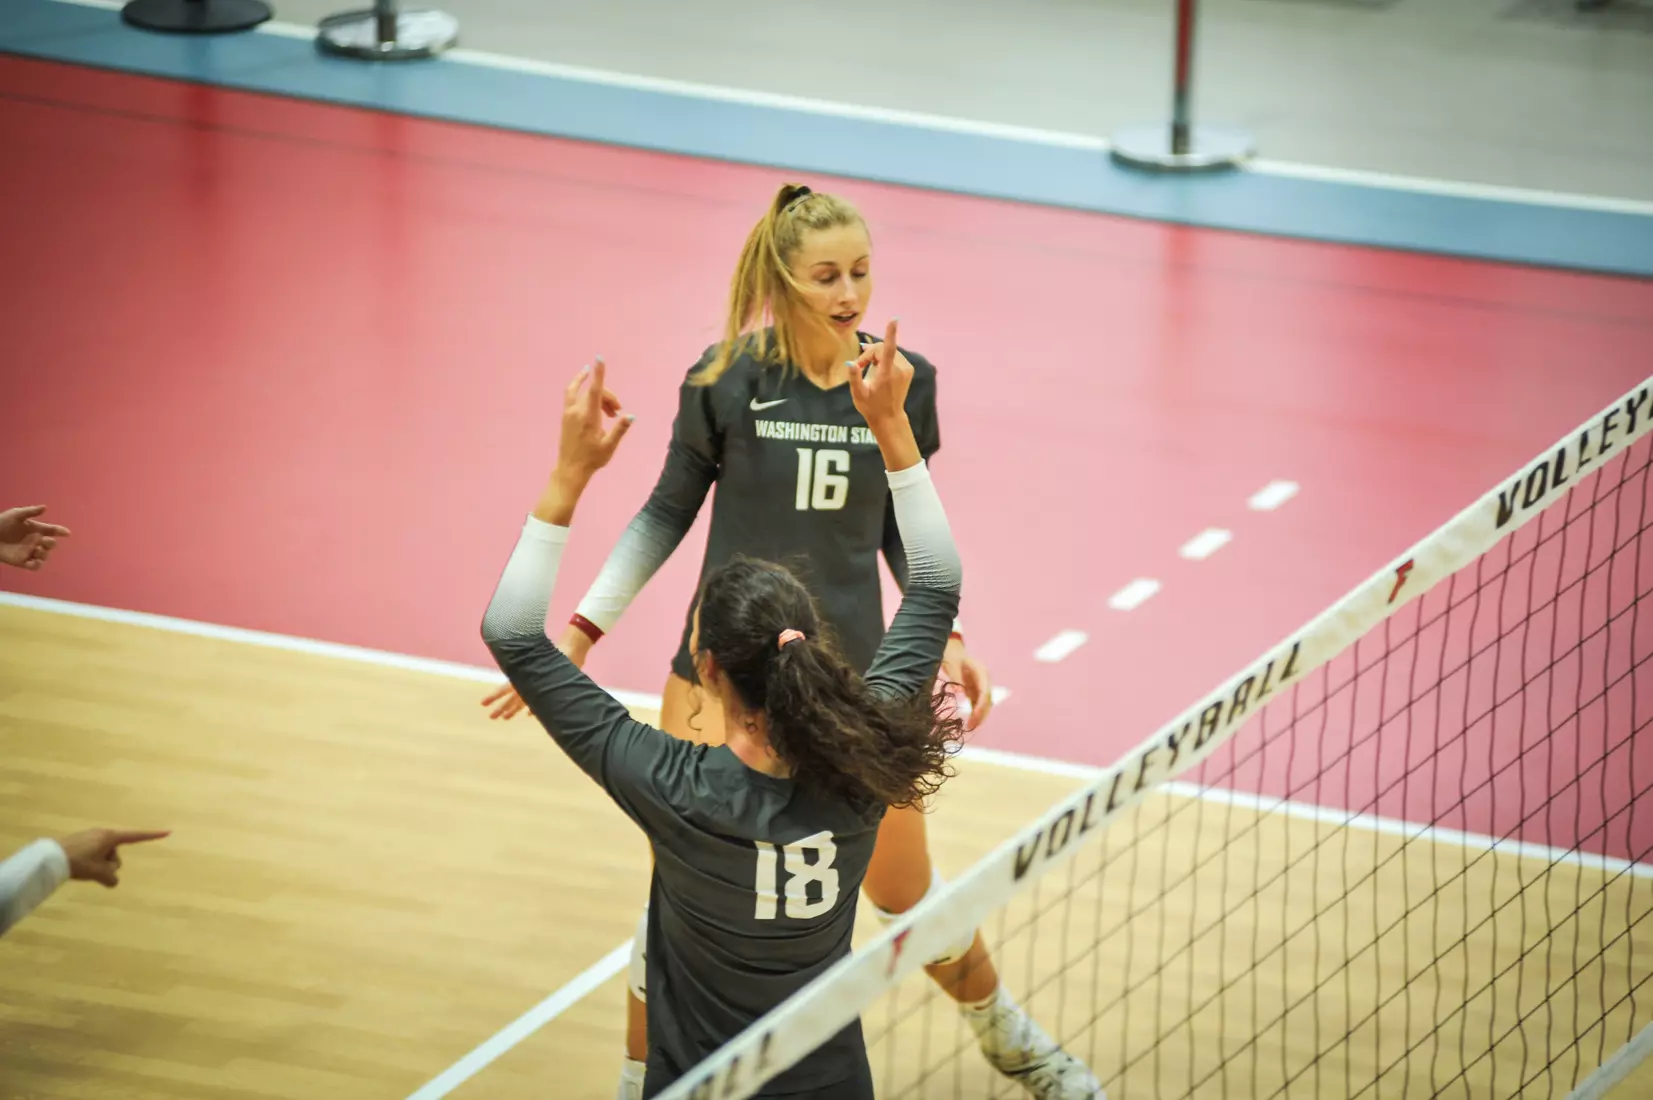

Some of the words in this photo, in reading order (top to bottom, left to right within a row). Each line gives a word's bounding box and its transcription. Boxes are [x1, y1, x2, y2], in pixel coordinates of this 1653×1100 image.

[755, 419, 848, 443] WASHINGTON
[851, 426, 878, 445] STA
[1496, 387, 1653, 529] VOLLEY
[795, 447, 850, 511] 16
[1013, 640, 1301, 882] VOLLEYBALL
[754, 830, 840, 920] 18
